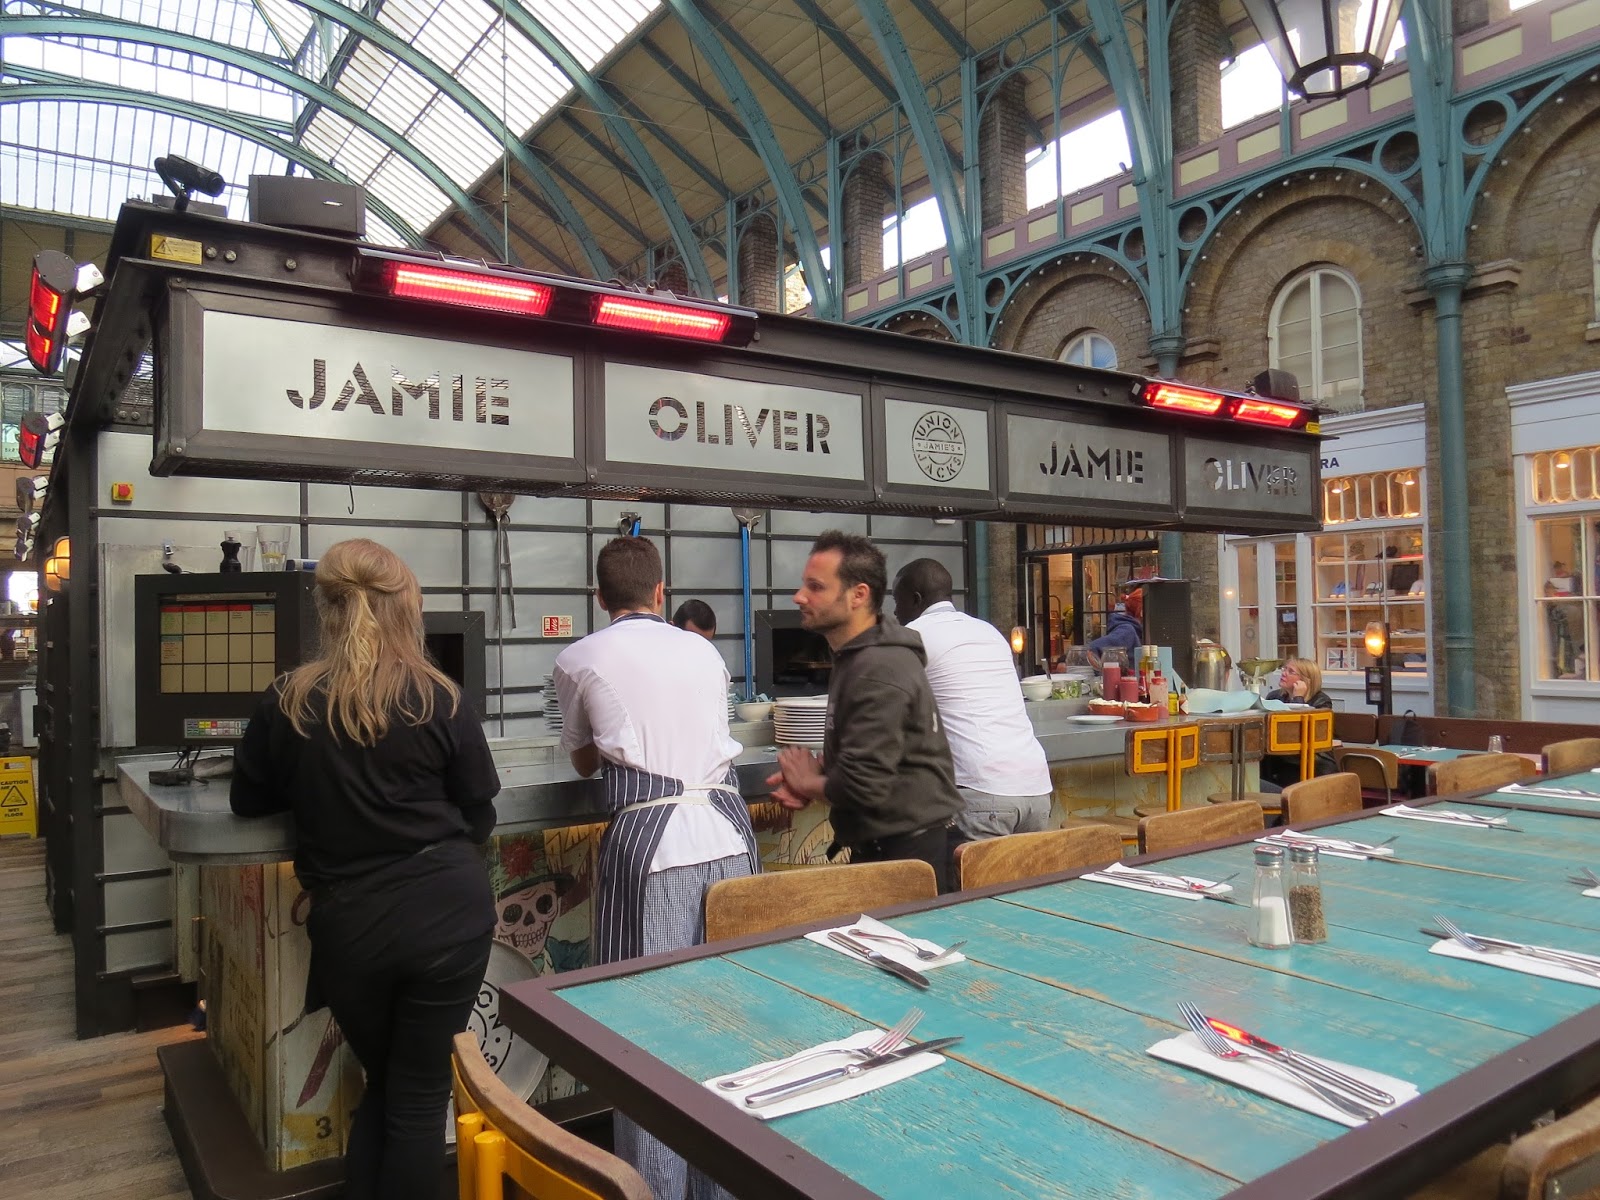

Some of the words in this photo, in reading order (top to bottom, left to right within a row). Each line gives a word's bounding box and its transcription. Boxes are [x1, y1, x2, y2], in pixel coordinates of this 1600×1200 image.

[286, 358, 510, 426] JAMIE
[648, 396, 831, 455] OLIVER
[916, 414, 961, 440] UNION
[923, 442, 956, 453] JAMIE'S
[917, 454, 962, 479] JACKS
[1039, 441, 1144, 484] JAMIE
[1203, 456, 1298, 496] OLIVER
[315, 1116, 333, 1140] 3
